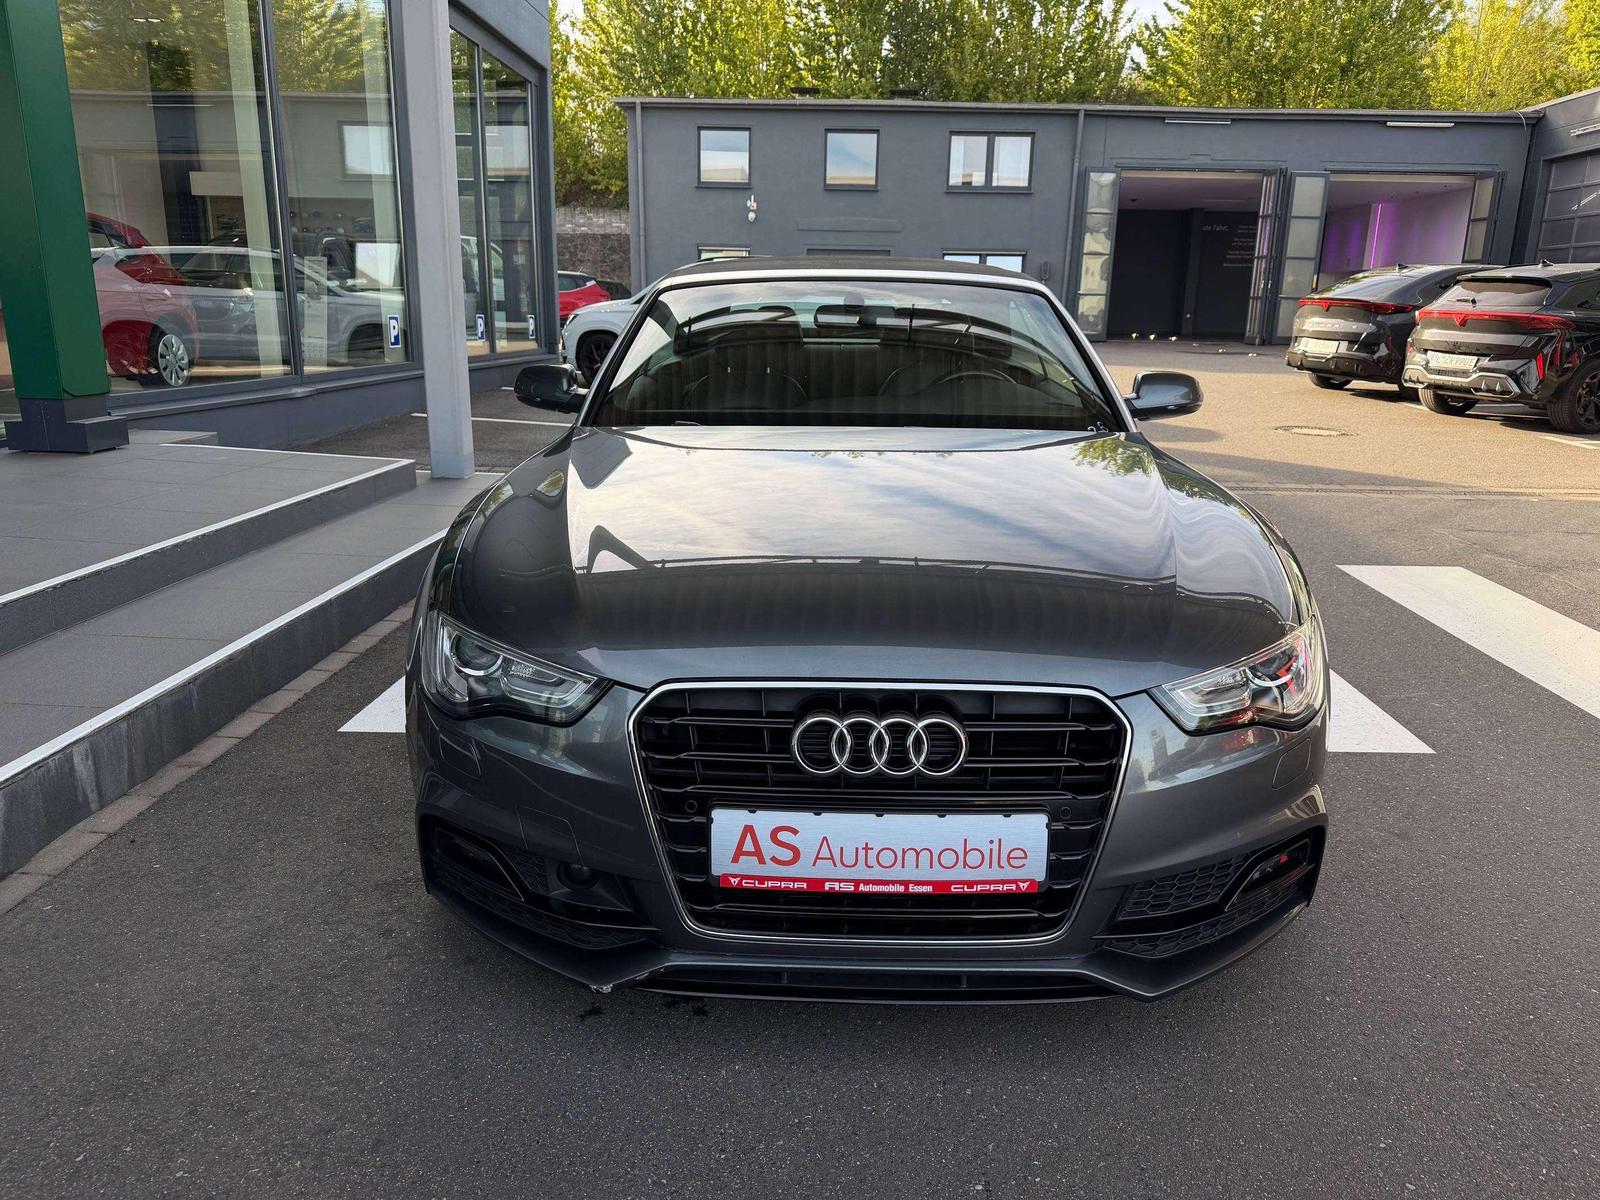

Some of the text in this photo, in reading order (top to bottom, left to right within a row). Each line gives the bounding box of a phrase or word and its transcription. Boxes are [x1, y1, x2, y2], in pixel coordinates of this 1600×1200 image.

[390, 319, 399, 343] P
[731, 824, 1029, 869] AS Automobile
[742, 880, 1016, 892] CUPRA AS Automobile Essen CUPRA
